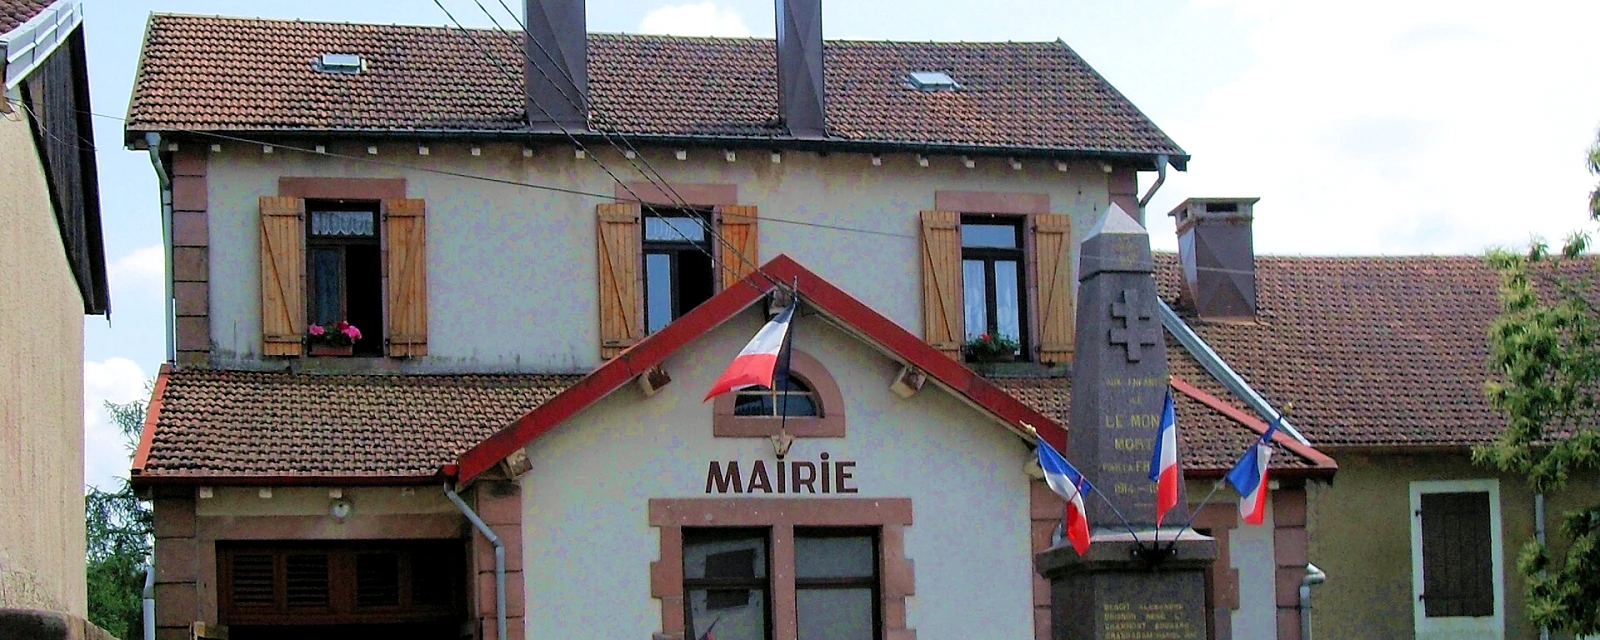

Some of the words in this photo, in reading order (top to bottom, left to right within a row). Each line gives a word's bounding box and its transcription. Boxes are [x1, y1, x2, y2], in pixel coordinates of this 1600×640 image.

[1105, 414, 1124, 428] LE
[1131, 414, 1159, 428] MON
[1114, 438, 1151, 451] MORT
[706, 452, 858, 494] MAIRIE
